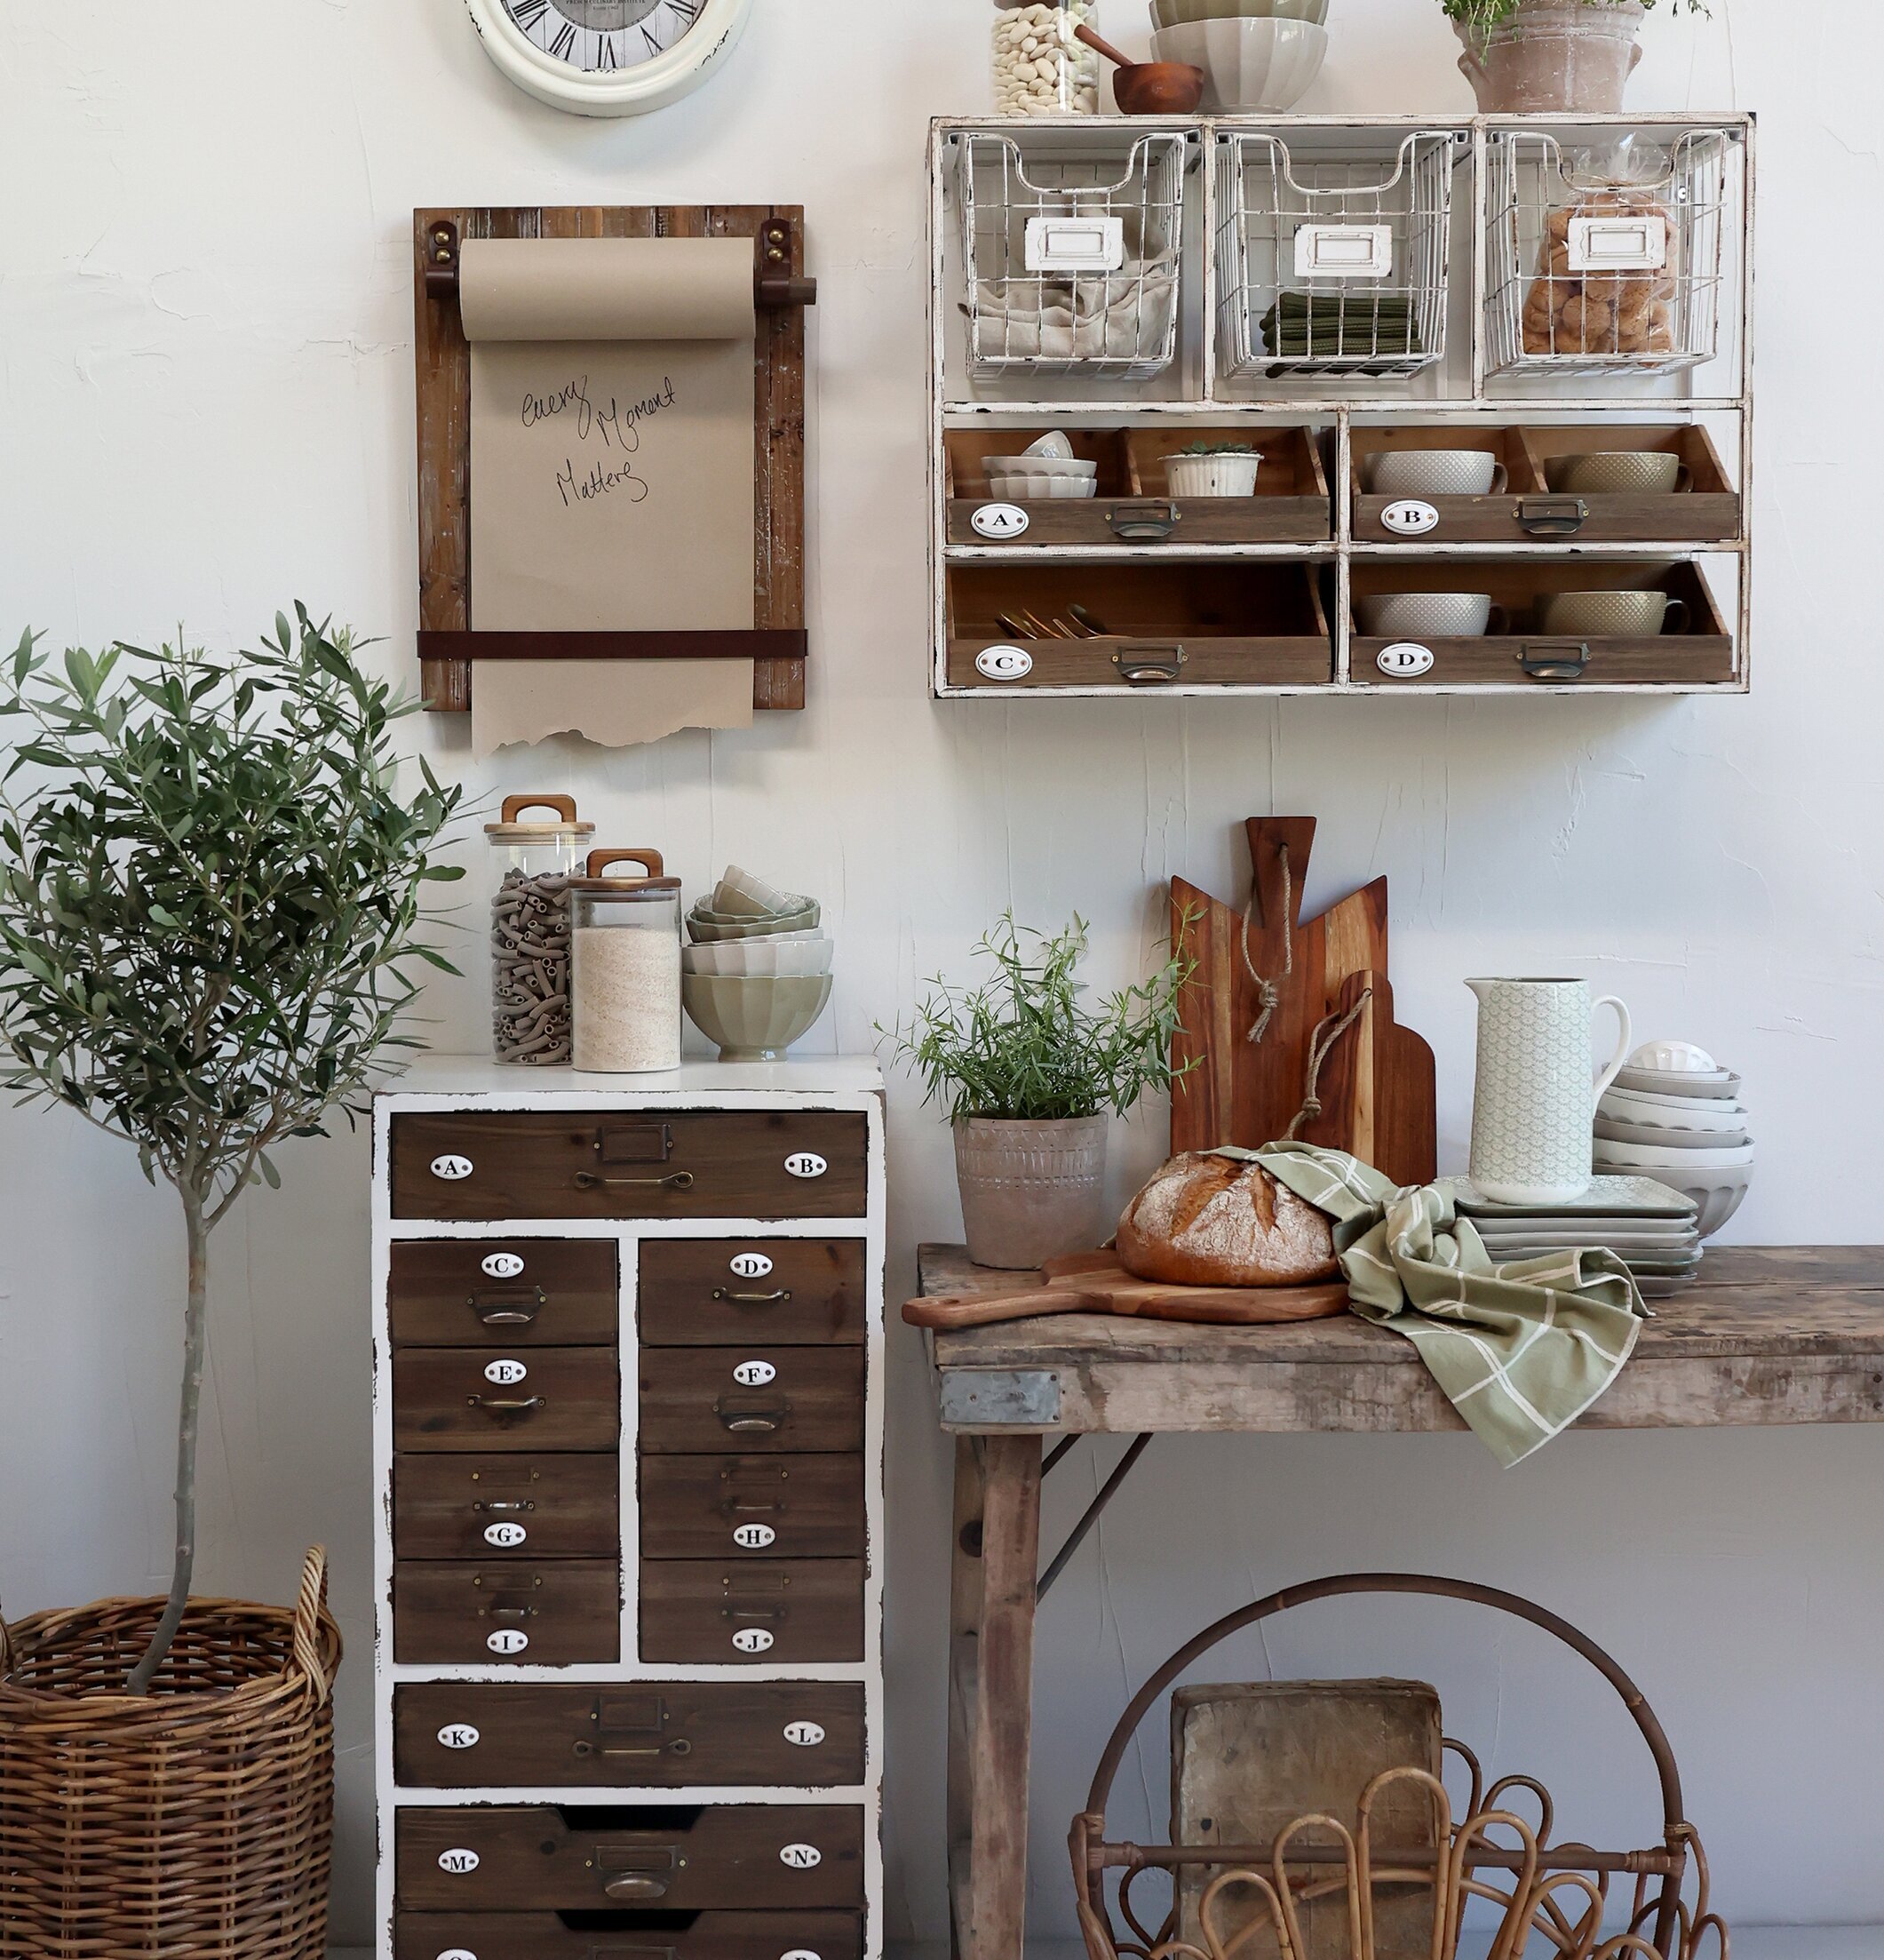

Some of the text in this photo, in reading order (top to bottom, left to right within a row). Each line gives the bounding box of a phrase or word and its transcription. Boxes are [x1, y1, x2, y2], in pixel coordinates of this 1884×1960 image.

[639, 24, 665, 58] V
[593, 33, 619, 69] VI
[596, 376, 676, 452] Moment
[555, 458, 648, 506] Matters
[992, 514, 1010, 526] A
[1403, 511, 1420, 522] B
[995, 657, 1014, 669] C
[1397, 654, 1416, 666] D
[444, 1160, 458, 1175] A
[800, 1159, 813, 1173] B
[495, 1258, 509, 1273] C
[744, 1260, 758, 1274] D
[499, 1366, 513, 1381] E
[747, 1368, 759, 1382] F
[497, 1527, 512, 1542] G
[746, 1530, 760, 1544] H
[502, 1636, 510, 1650] I
[748, 1636, 759, 1650] J
[452, 1731, 465, 1745] K
[799, 1728, 811, 1742] L
[449, 1856, 465, 1870] M
[794, 1850, 808, 1865] N
